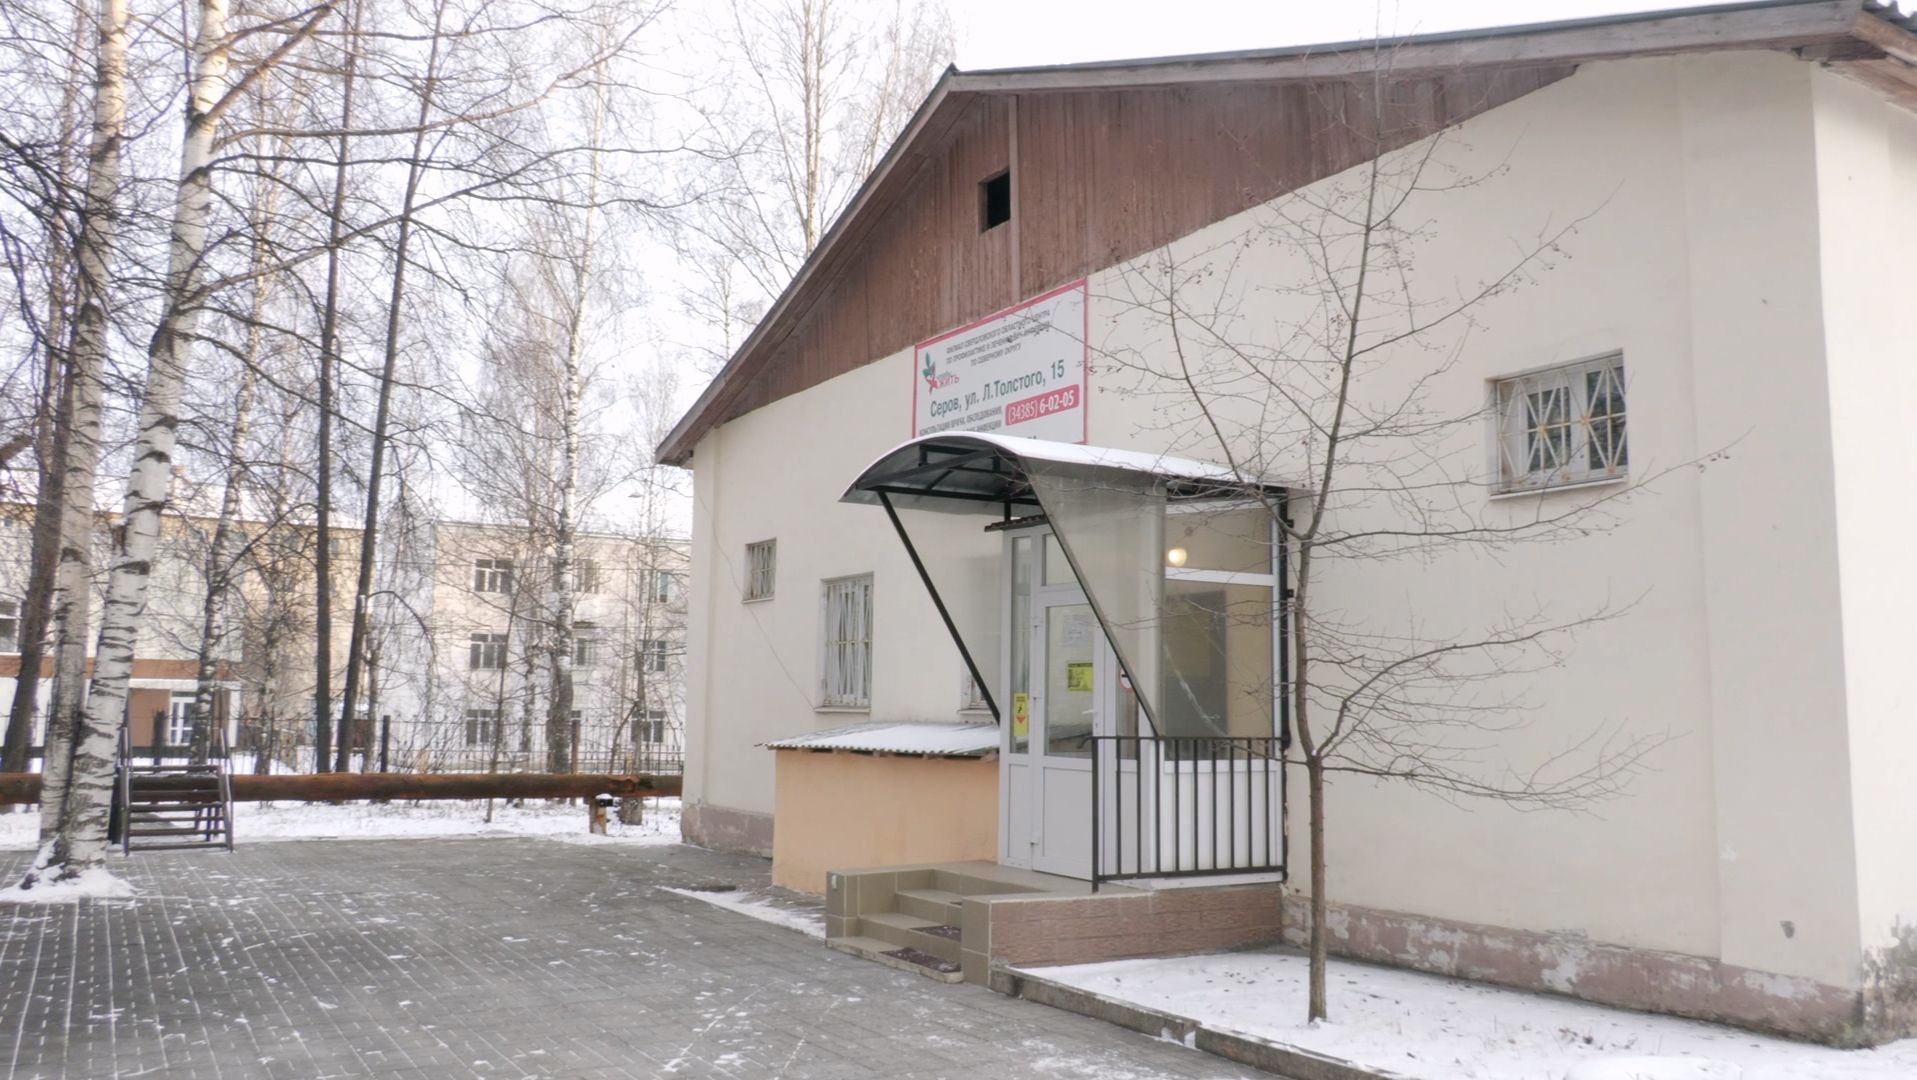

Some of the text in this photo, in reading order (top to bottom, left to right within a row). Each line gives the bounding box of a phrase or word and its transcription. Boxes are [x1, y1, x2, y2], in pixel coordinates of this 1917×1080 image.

[930, 359, 1065, 418] Серов, ул. Л.Толстого, 15
[1008, 389, 1074, 425] (34385) 6-02-05
